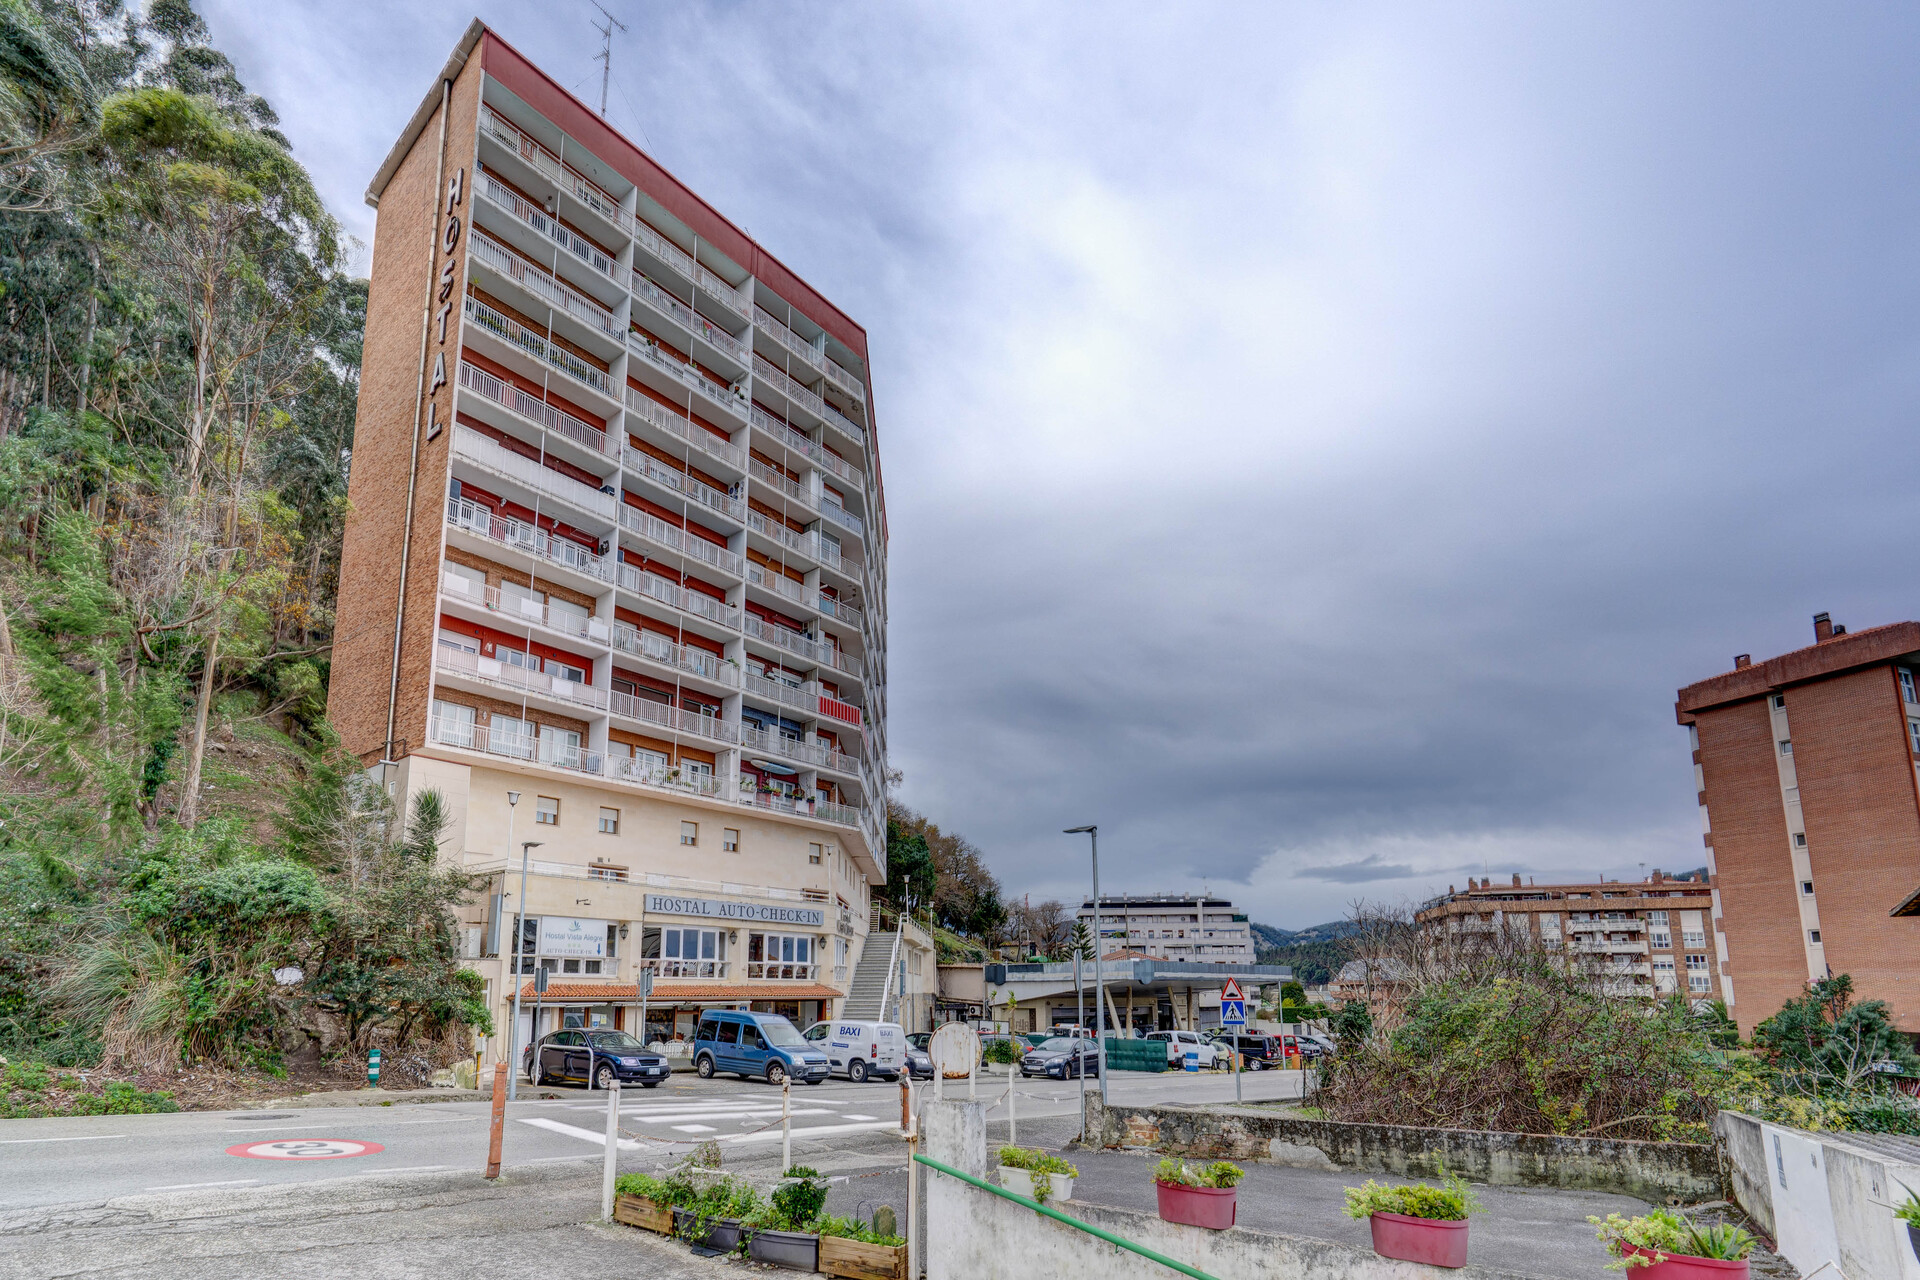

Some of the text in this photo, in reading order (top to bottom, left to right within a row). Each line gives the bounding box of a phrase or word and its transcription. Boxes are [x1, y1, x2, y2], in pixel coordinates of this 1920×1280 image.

[426, 167, 464, 442] HOSTAL
[652, 897, 711, 915] HOSTAL
[718, 904, 820, 924] AUTO-CHECK-IN
[545, 932, 566, 940] Hostal
[583, 934, 603, 943] Alegre
[840, 1026, 861, 1037] BAXI
[880, 1029, 893, 1037] BAXI
[271, 1142, 344, 1156] 30
